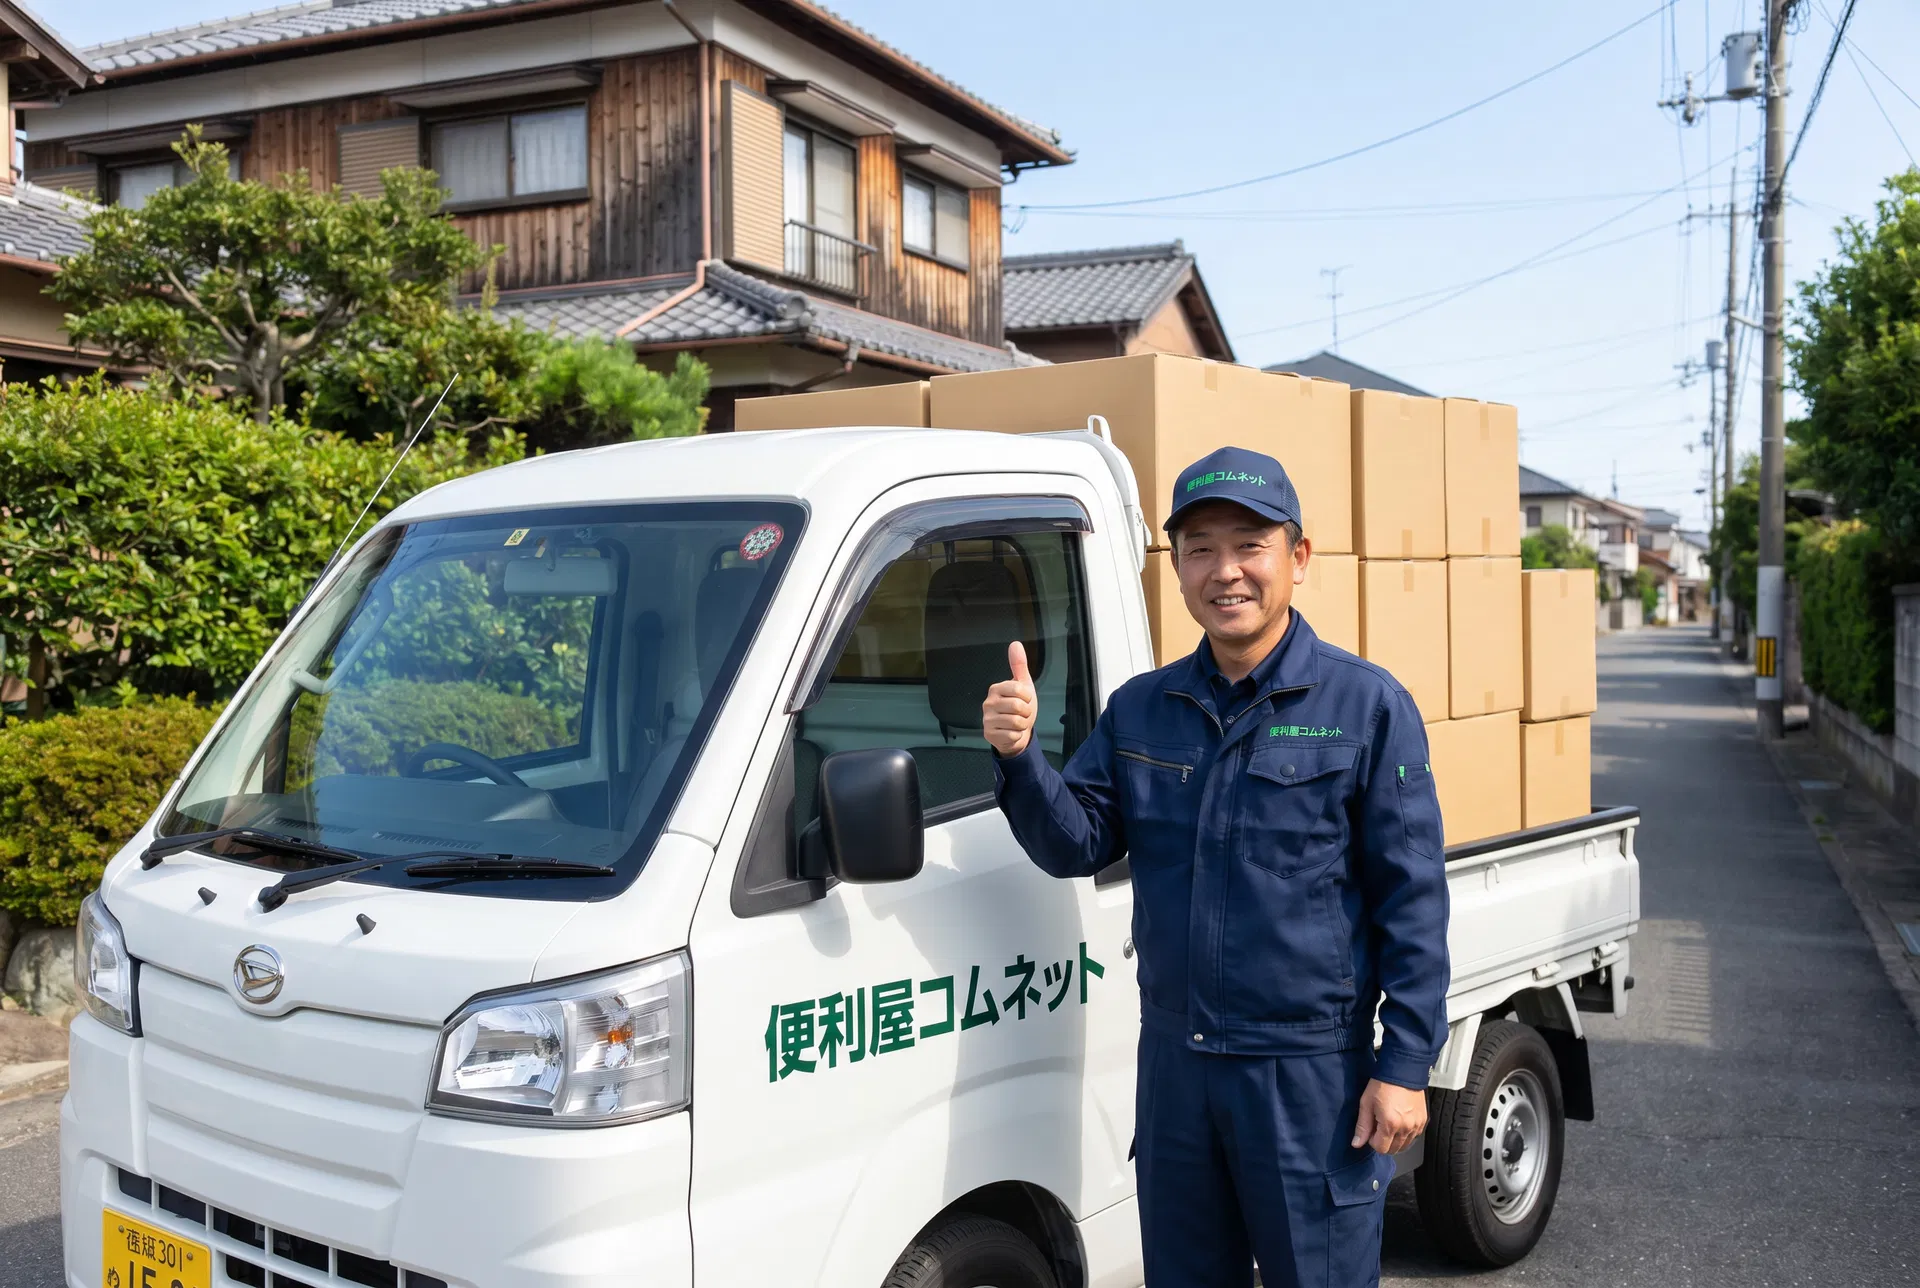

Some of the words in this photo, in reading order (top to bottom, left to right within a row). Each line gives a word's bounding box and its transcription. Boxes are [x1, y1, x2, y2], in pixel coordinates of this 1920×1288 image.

[764, 941, 1105, 1083] 便利屋コムネット
